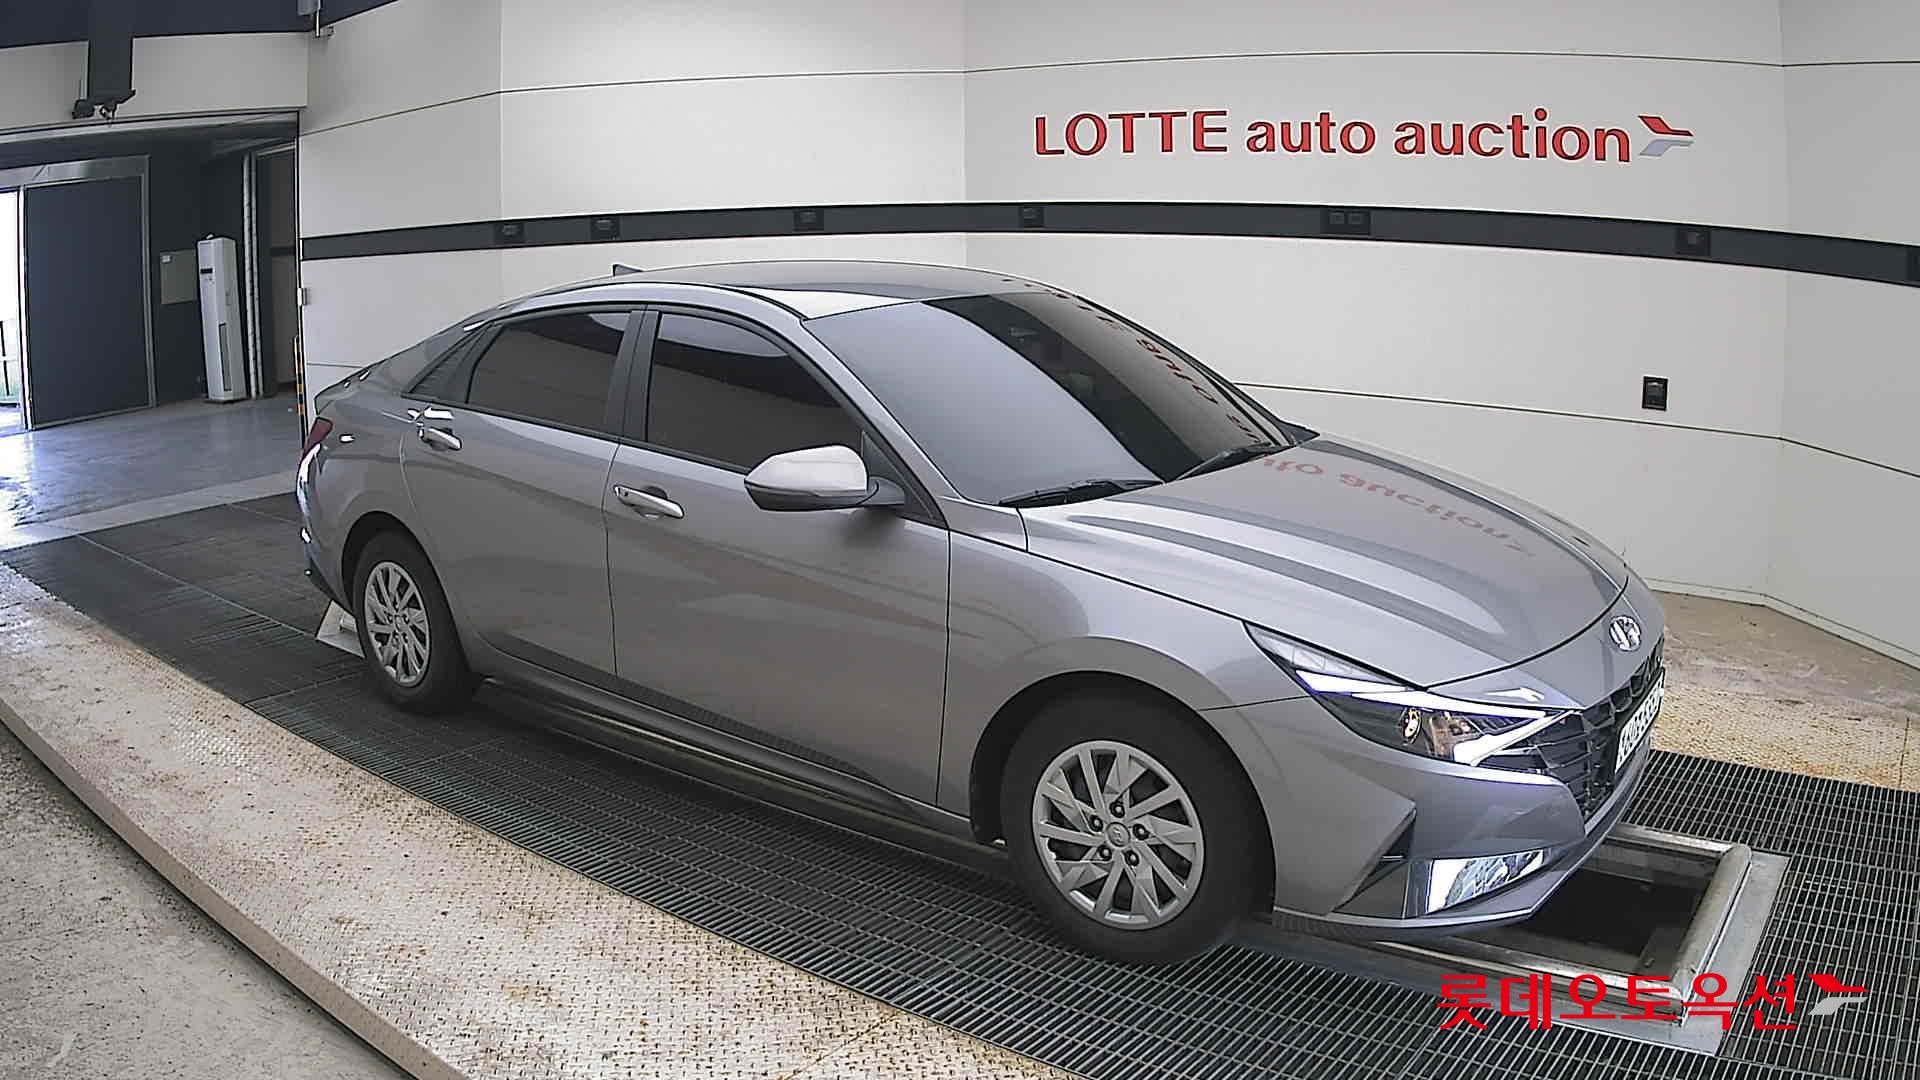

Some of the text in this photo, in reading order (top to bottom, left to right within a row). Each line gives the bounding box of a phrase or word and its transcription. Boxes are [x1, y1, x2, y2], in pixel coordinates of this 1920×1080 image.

[1035, 108, 1631, 162] LOTTE auto auction
